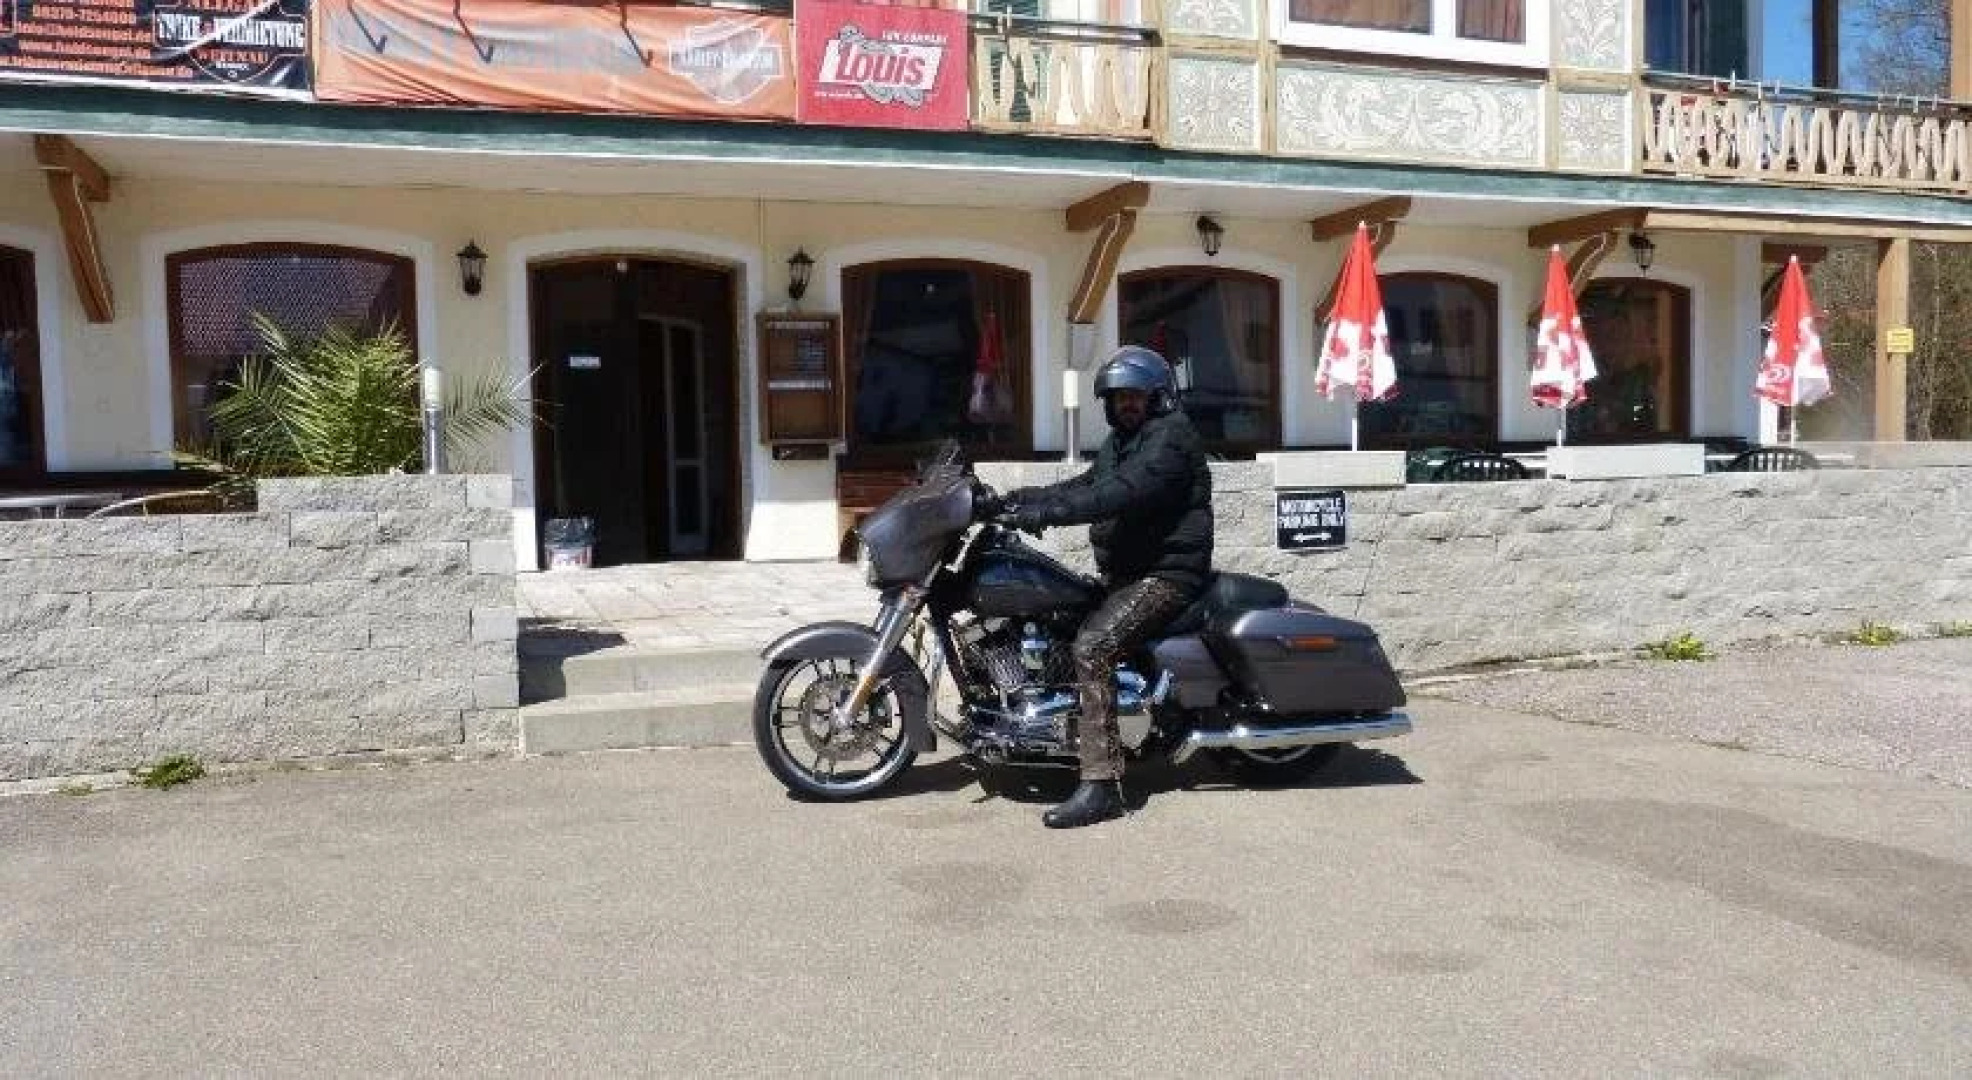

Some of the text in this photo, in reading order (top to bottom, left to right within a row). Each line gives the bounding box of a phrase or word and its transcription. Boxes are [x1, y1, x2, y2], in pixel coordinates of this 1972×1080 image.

[835, 42, 926, 85] Louis
[1281, 498, 1343, 513] MOTORCYCLE
[1278, 512, 1344, 529] PARKING ONLY
